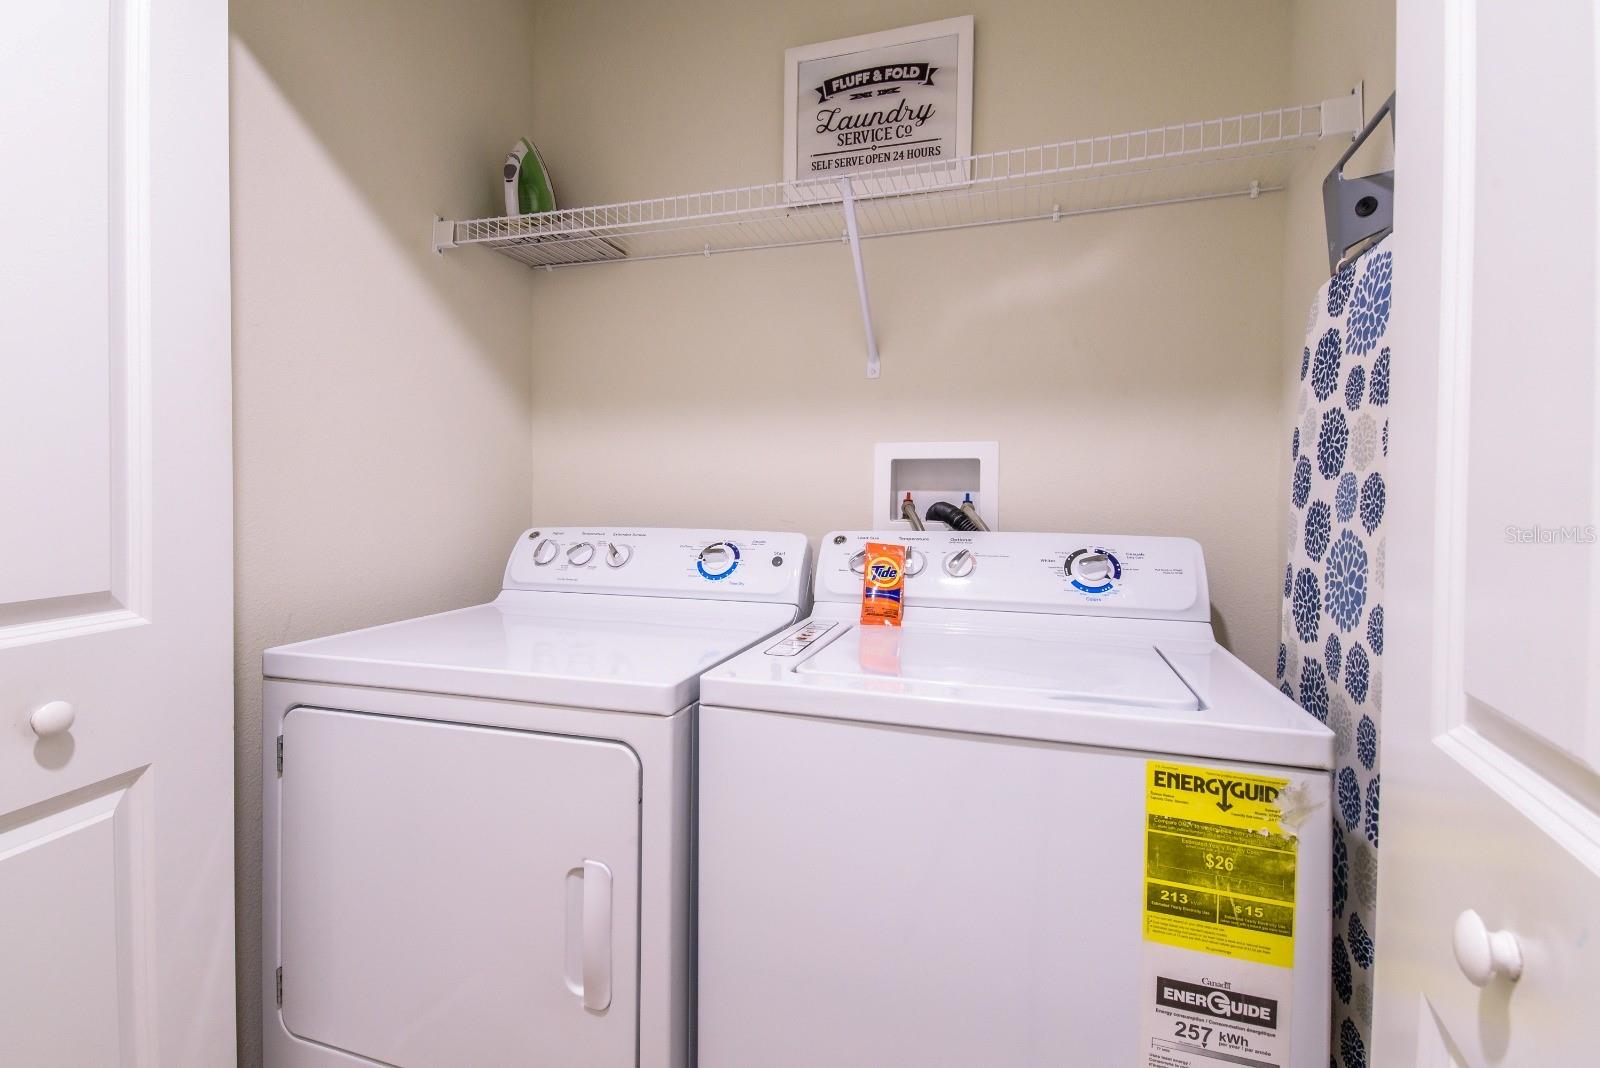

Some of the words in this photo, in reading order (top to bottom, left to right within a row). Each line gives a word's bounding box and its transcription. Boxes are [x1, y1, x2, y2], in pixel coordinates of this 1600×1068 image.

[832, 71, 870, 92] FLUFF
[872, 70, 882, 81] &
[884, 66, 921, 80] FOLD
[816, 98, 936, 134] Laundry
[837, 126, 893, 147] SERVICE
[811, 159, 834, 171] SELF
[834, 155, 865, 169] SERVE
[865, 151, 891, 165] OPEN
[892, 150, 905, 161] 24
[906, 146, 941, 160] HOURS
[871, 565, 898, 581] Tide
[1205, 854, 1234, 871] $26
[1160, 889, 1189, 904] 213
[1163, 986, 1271, 1021] ENERGUIDE
[1155, 1007, 1173, 1017] Energy
[1173, 1012, 1205, 1023] consumption
[1174, 1021, 1213, 1043] 257
[1219, 1031, 1249, 1048] kWh
[1228, 1043, 1241, 1051] year
